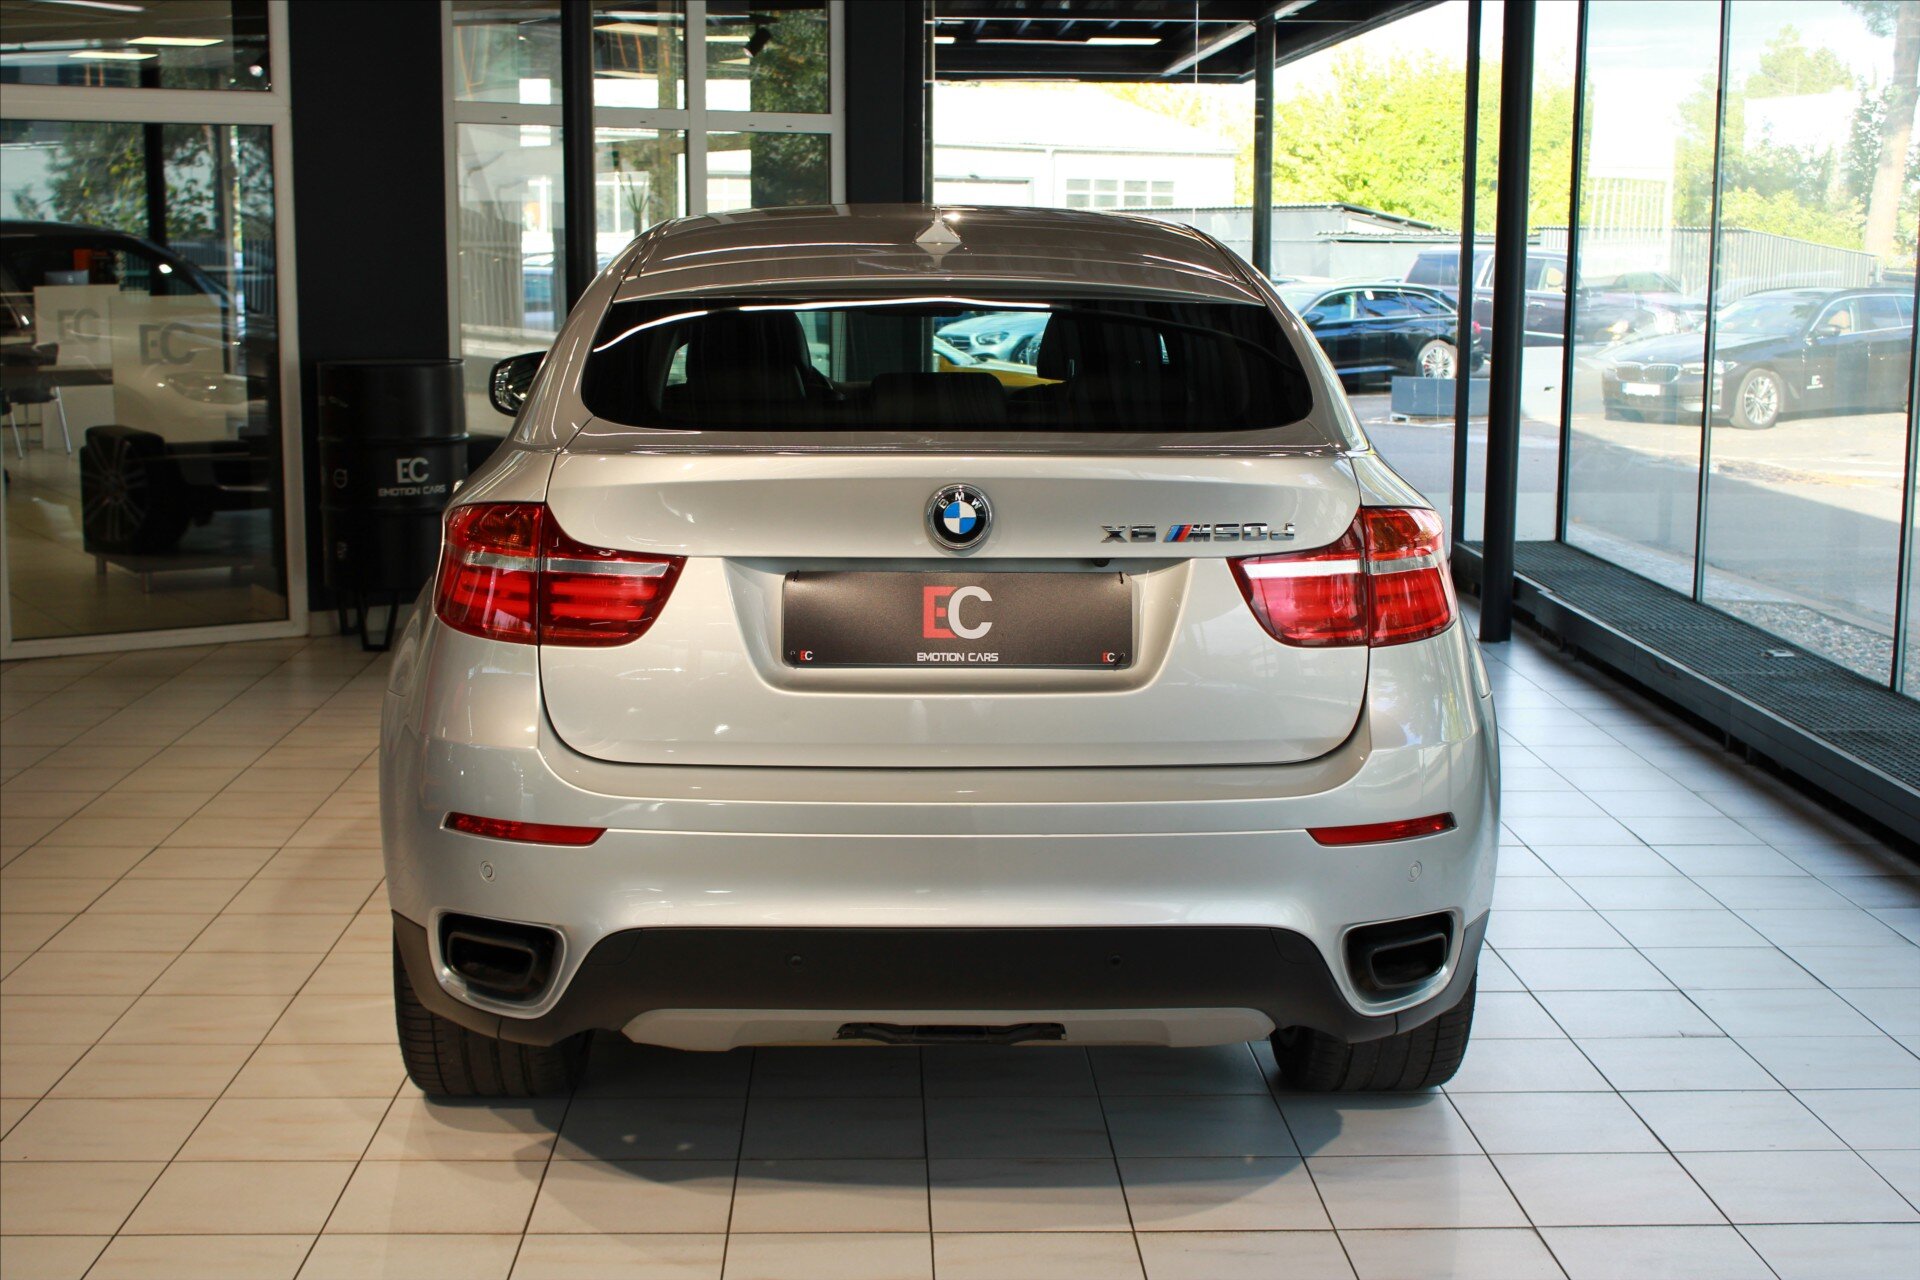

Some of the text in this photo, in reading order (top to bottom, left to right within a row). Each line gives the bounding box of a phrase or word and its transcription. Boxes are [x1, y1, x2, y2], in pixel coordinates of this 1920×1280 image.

[139, 322, 197, 364] EC
[396, 457, 429, 483] EC
[378, 484, 446, 496] EMOTION CARS
[938, 491, 982, 509] BMW
[1100, 524, 1156, 543] X6
[923, 585, 993, 640] EC
[800, 650, 813, 661] EC
[916, 652, 999, 662] EMOTION CARS
[1102, 651, 1116, 663] EC
